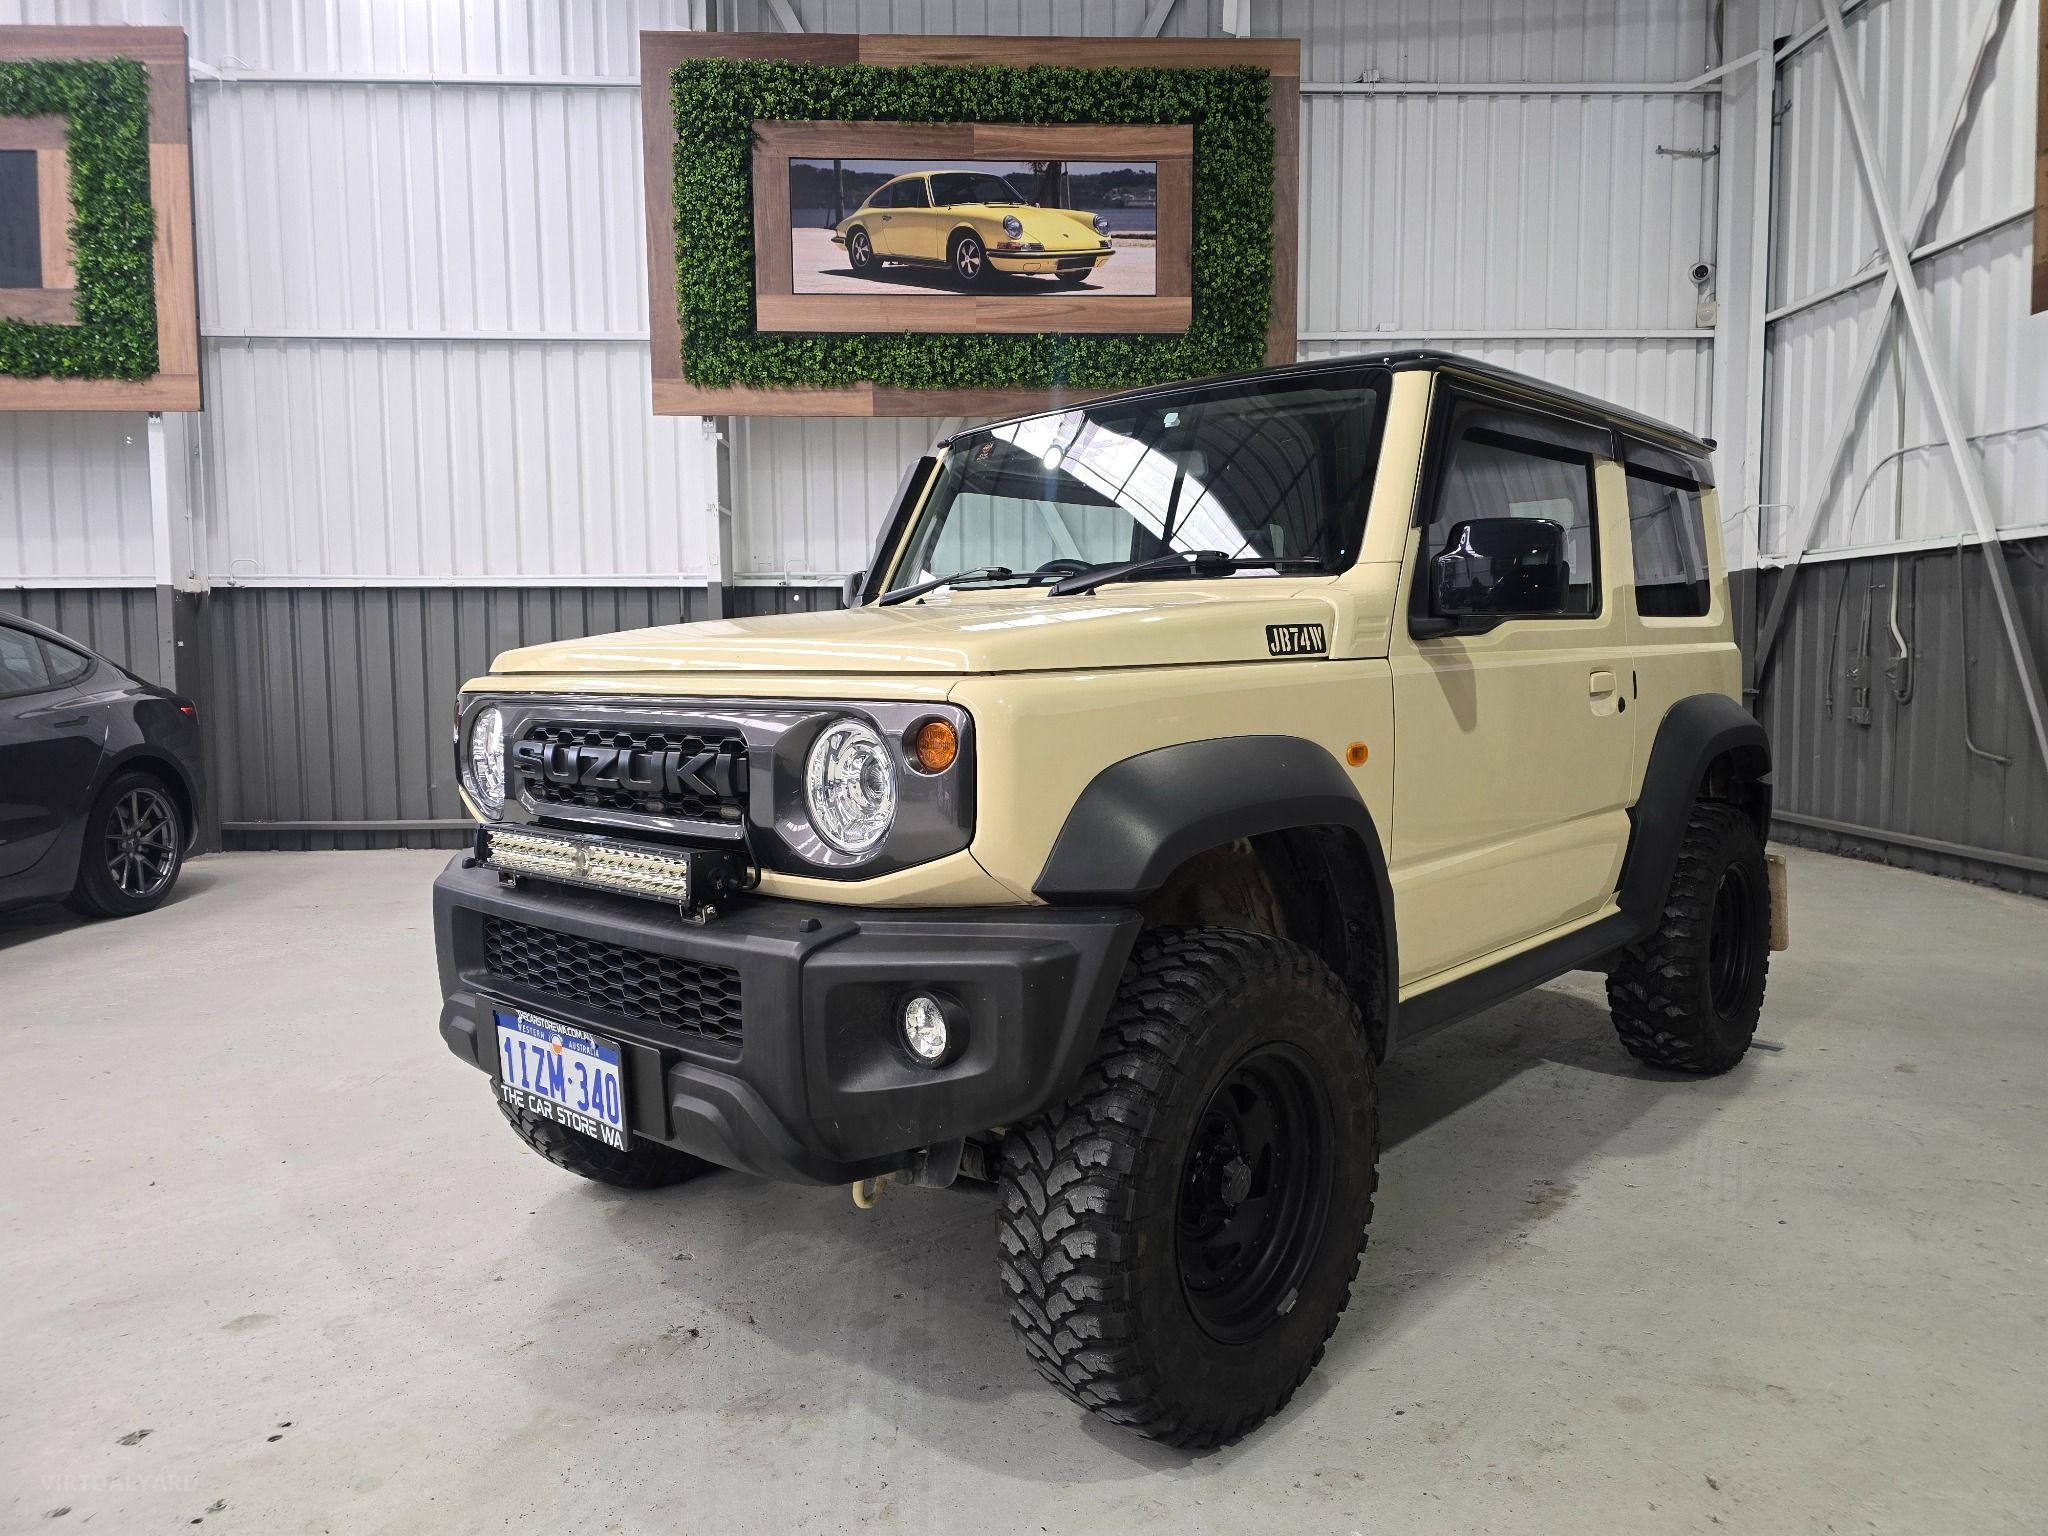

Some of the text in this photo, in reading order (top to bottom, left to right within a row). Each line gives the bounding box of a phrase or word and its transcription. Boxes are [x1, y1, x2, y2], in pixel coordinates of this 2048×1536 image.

[1270, 626, 1323, 653] JB74W
[512, 740, 732, 797] SUZUKI
[568, 1041, 600, 1058] AUSTRALIA
[501, 1084, 625, 1151] THE CAR STORE WA
